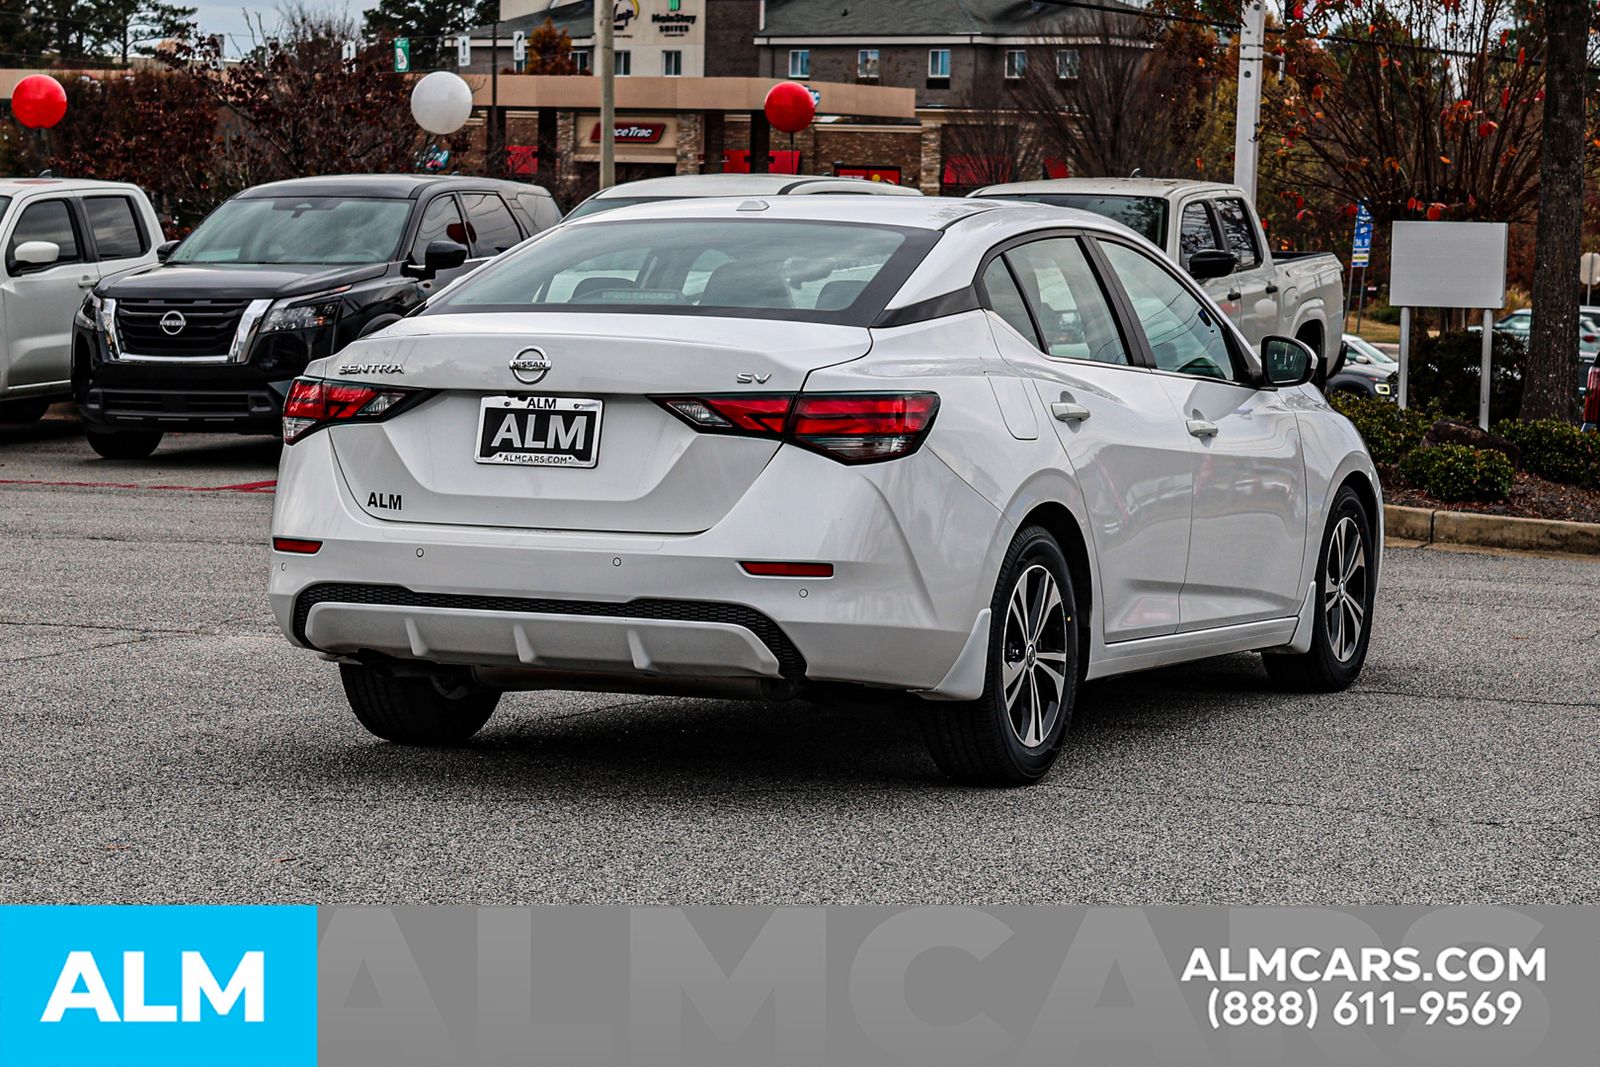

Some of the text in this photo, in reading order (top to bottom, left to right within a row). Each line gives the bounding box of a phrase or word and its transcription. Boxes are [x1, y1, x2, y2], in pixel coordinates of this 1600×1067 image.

[652, 13, 697, 24] MainStay
[614, 126, 653, 136] ceTrac
[339, 363, 405, 376] SENTRA
[736, 372, 772, 385] SV
[526, 397, 557, 409] ALM
[490, 413, 588, 450] ALM
[503, 454, 568, 464] ALMCARS.COM
[367, 491, 402, 511] ALM
